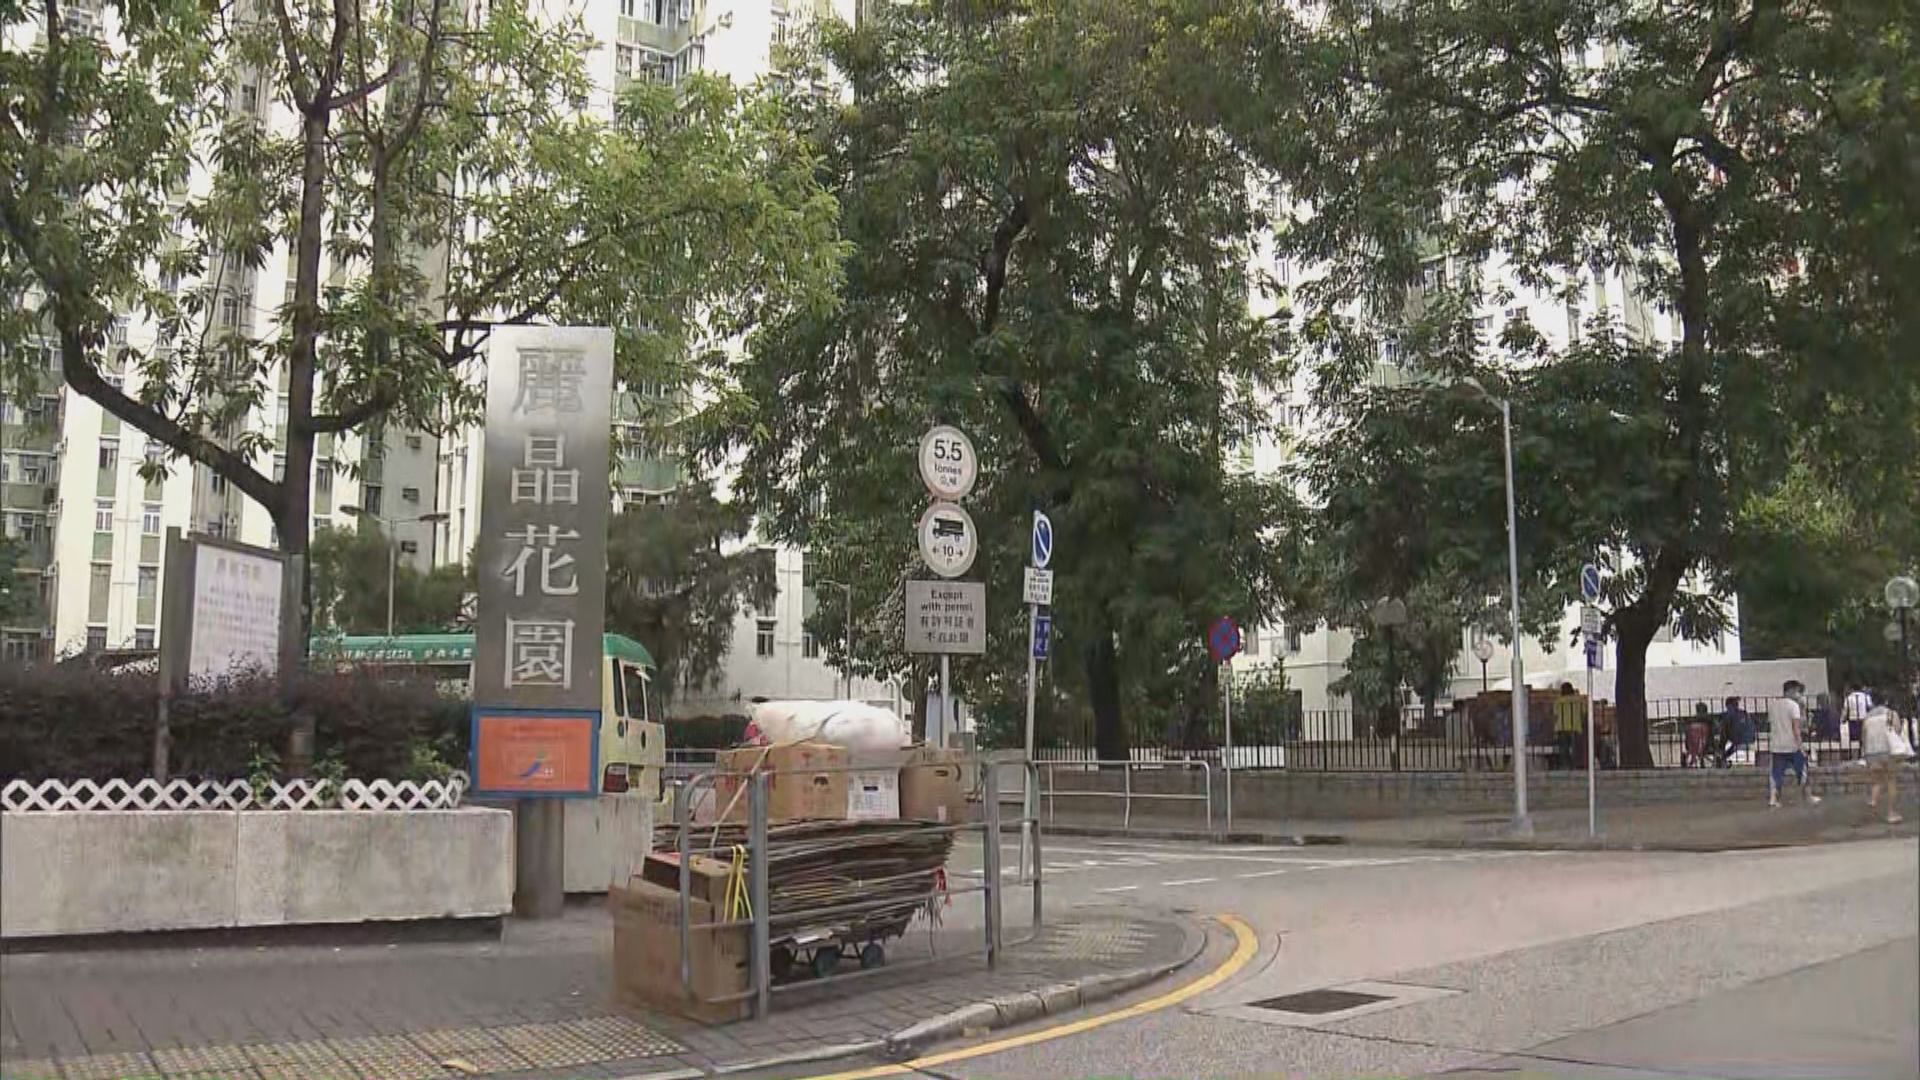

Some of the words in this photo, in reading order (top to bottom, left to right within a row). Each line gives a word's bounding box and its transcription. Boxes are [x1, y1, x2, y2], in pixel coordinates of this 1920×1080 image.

[501, 346, 588, 690] 麗晶花園
[942, 544, 954, 556] 10
[931, 589, 963, 600] Except
[921, 601, 941, 611] with
[944, 602, 973, 613] permit
